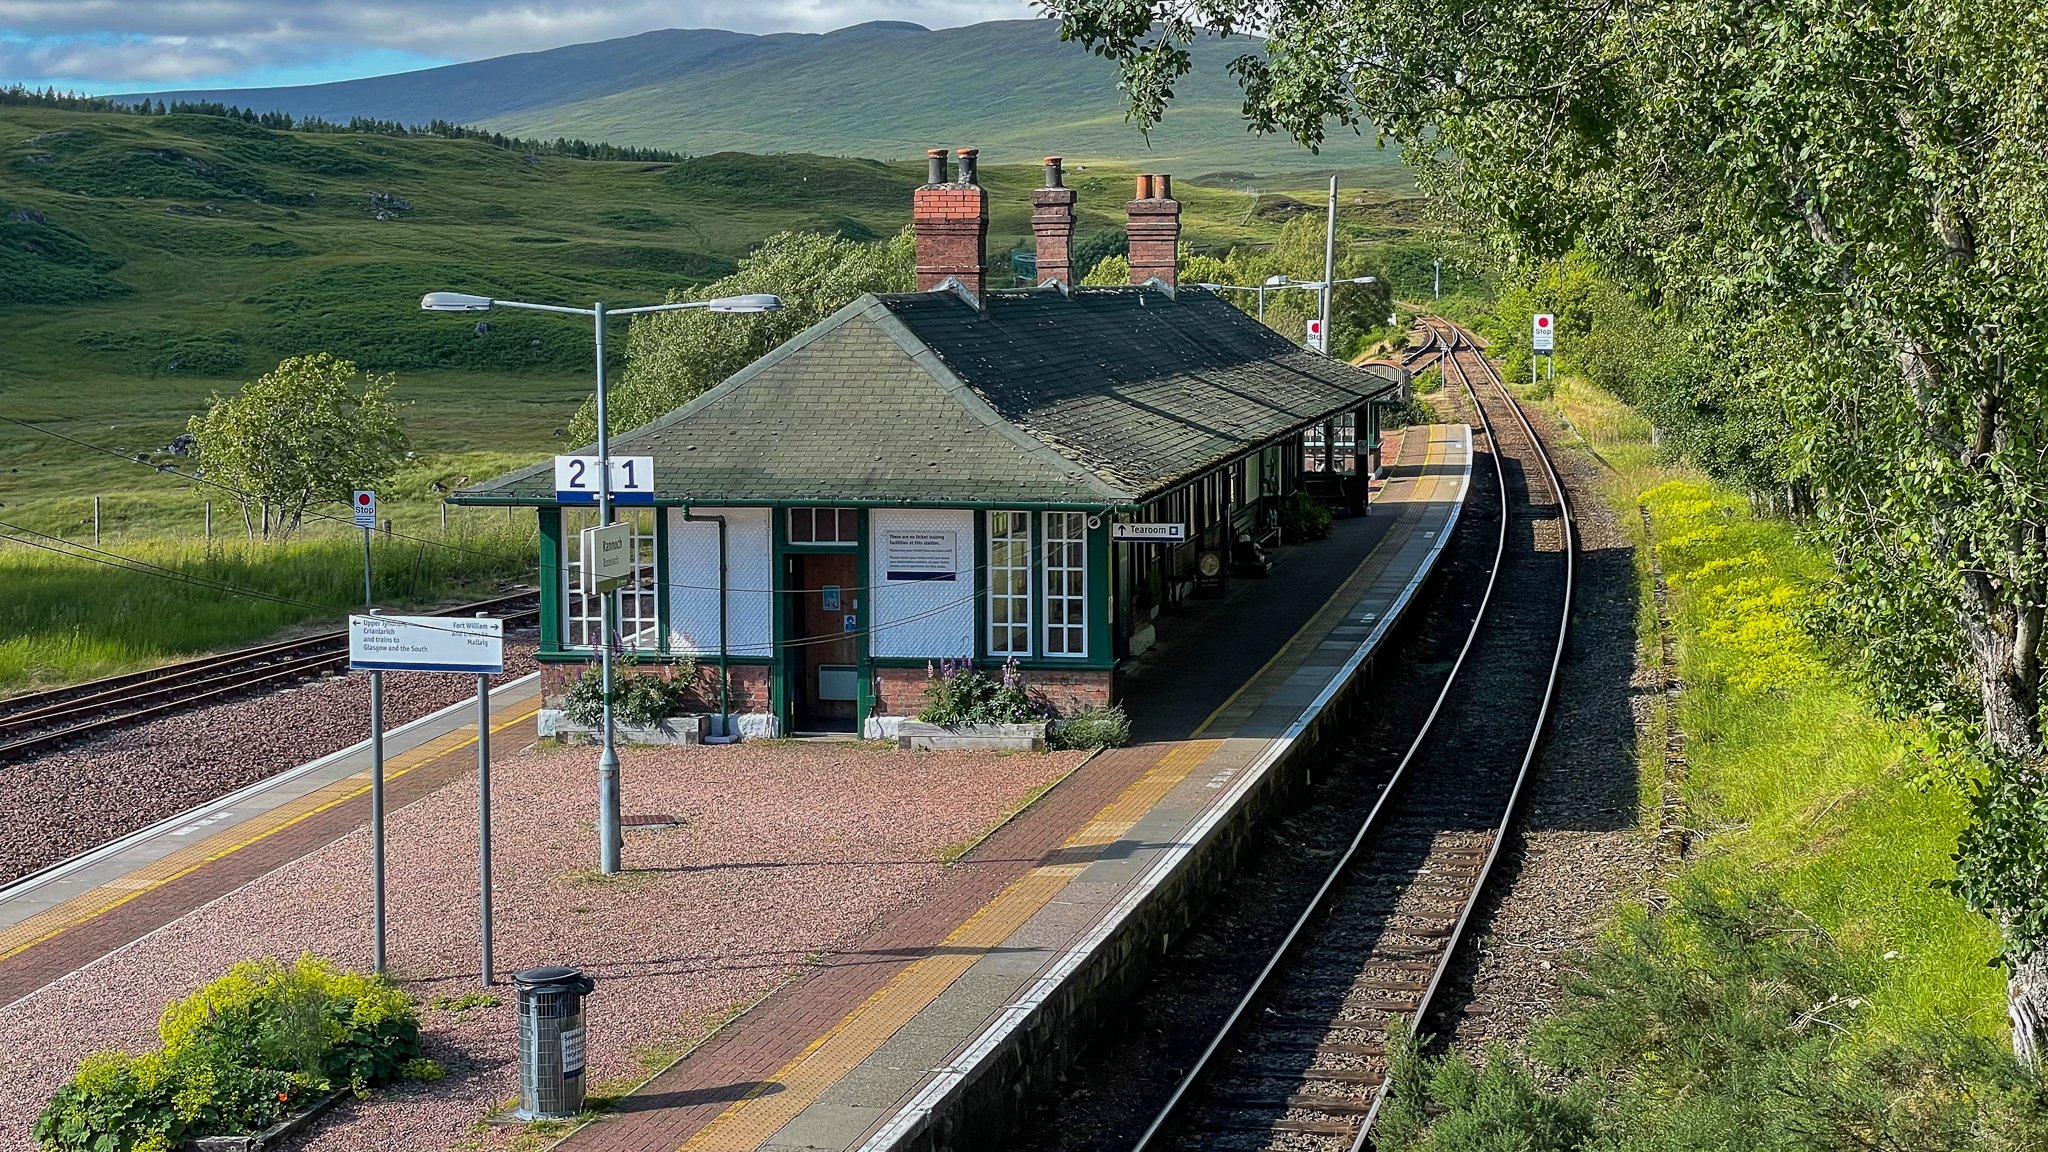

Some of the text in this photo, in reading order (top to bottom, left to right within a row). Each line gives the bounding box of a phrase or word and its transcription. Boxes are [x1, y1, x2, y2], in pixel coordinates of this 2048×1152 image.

[569, 459, 586, 488] 2
[621, 459, 639, 489] 1
[1130, 525, 1166, 534] Tearoom
[603, 537, 622, 552] Rannoch
[363, 619, 381, 627] Upper
[453, 621, 488, 630] Fort William
[467, 639, 488, 647] Mallaig
[363, 644, 388, 653] Glasgow
[400, 645, 411, 653] the
